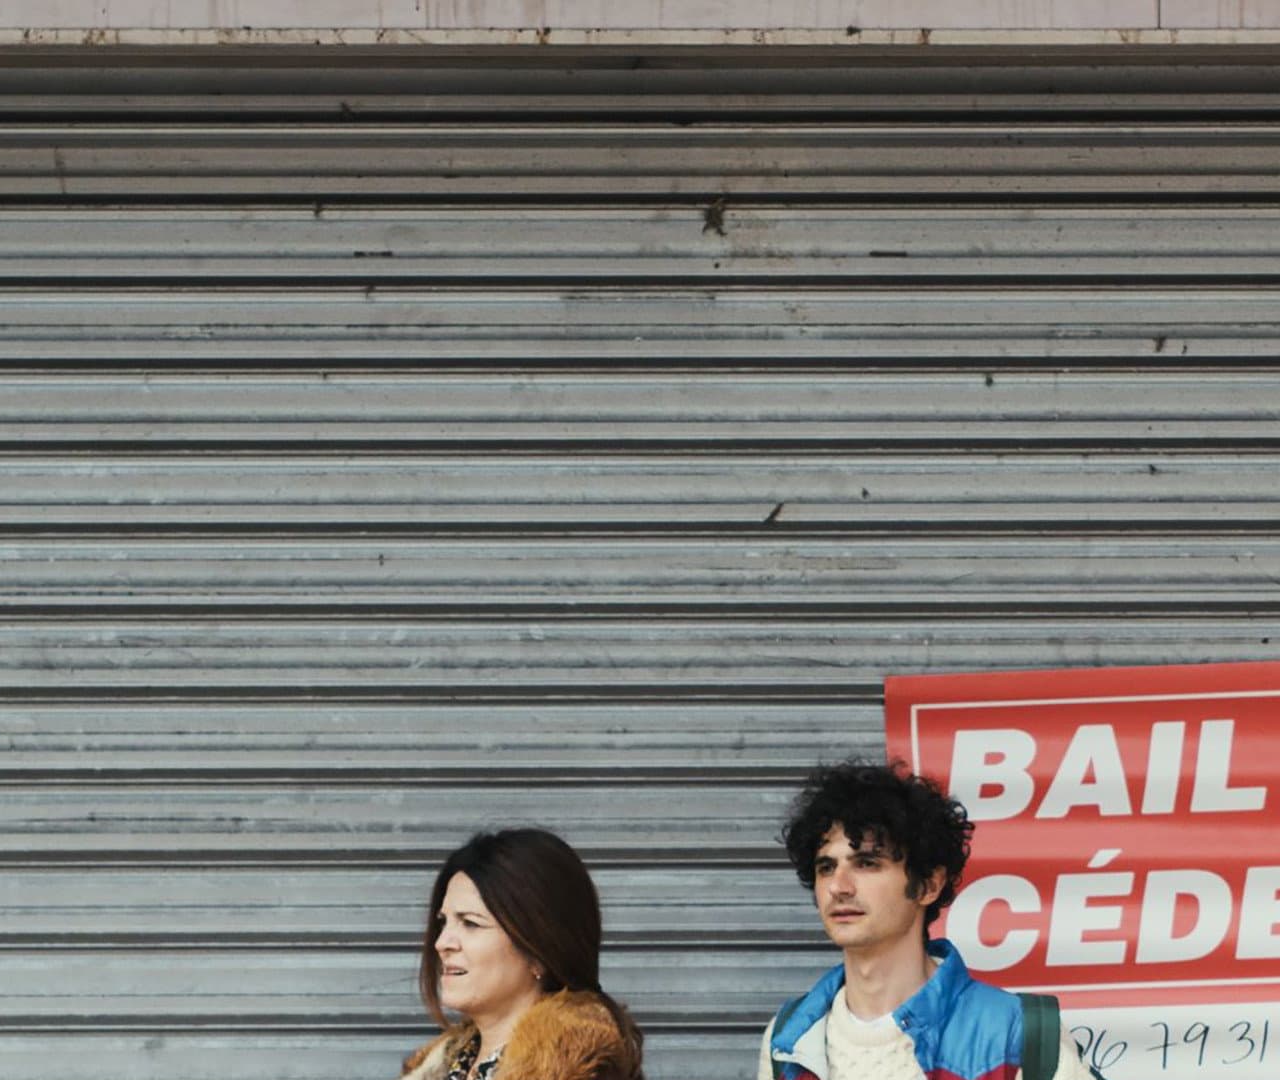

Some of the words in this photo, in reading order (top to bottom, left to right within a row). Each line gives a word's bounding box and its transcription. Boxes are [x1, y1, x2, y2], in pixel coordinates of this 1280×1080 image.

[947, 719, 1268, 822] BAIL
[1146, 1021, 1211, 1070] 79
[1221, 1019, 1270, 1065] 31
